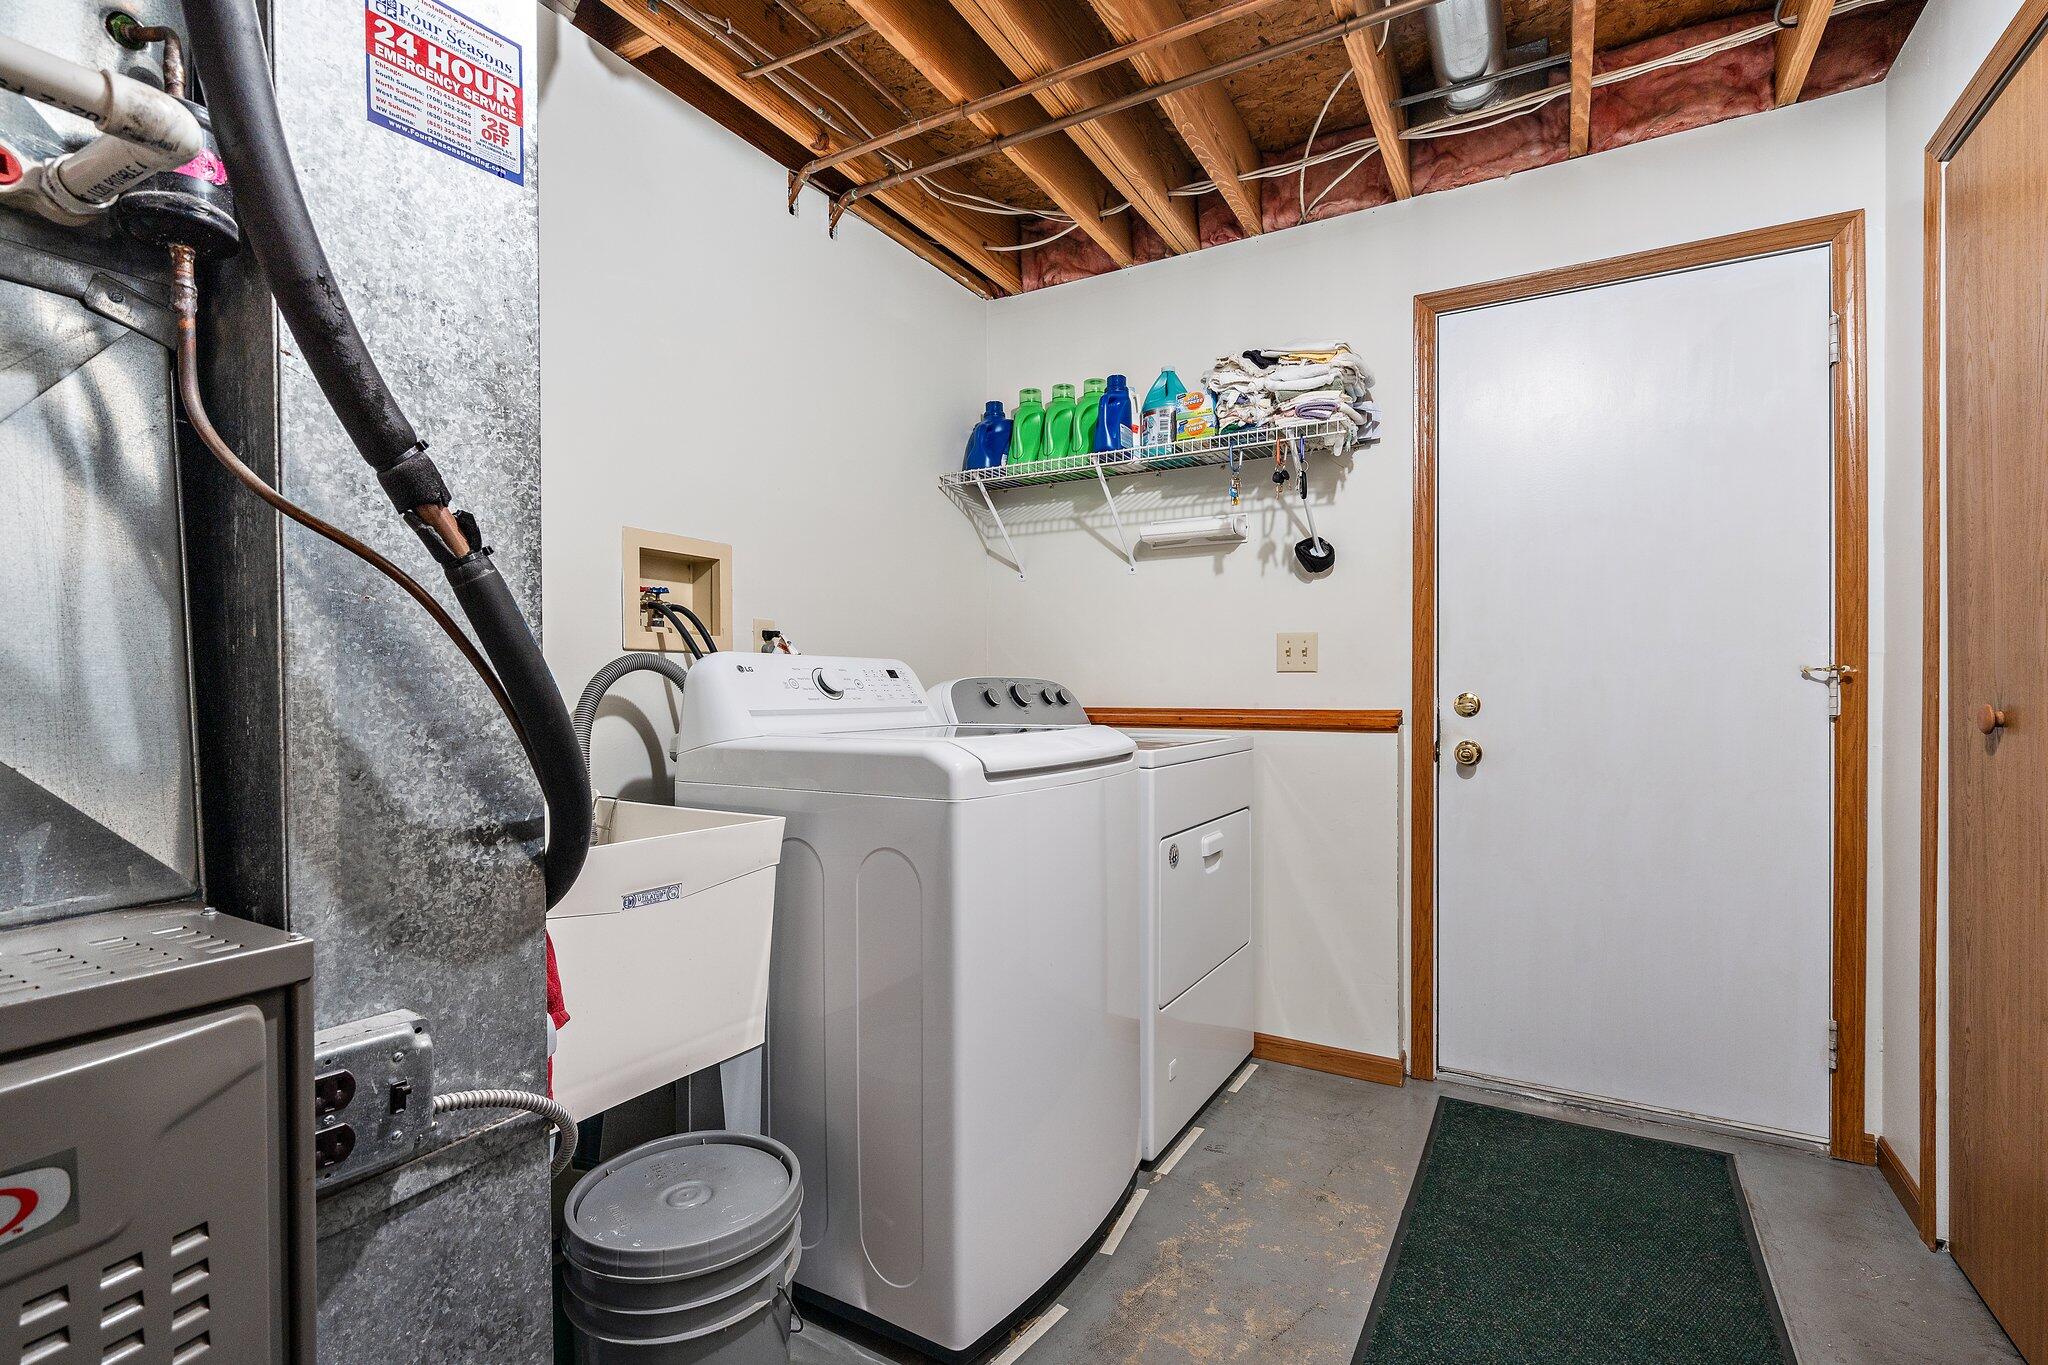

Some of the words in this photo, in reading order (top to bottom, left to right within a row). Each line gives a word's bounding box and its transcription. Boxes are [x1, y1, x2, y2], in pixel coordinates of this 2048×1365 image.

[398, 18, 425, 36] HEATING
[399, 3, 442, 35] Four
[446, 28, 512, 74] Seasons
[374, 19, 418, 58] 24
[428, 44, 516, 110] HOUR
[375, 60, 403, 78] Chicago:
[375, 44, 461, 93] EMERGENCY
[463, 85, 516, 121] SERVICE
[375, 69, 394, 82] South
[396, 79, 424, 97] Suburbs:
[375, 79, 394, 91] North
[396, 88, 424, 105] Suburbs:
[375, 87, 393, 99] West
[394, 96, 422, 112] Suburbs:
[375, 96, 386, 104] SW
[388, 101, 416, 118] Suburbs:
[375, 105, 387, 113] NW
[388, 109, 416, 126] Indiana:
[388, 119, 507, 176] www.FourSeasonsHeating.com
[482, 128, 509, 147] OFF
